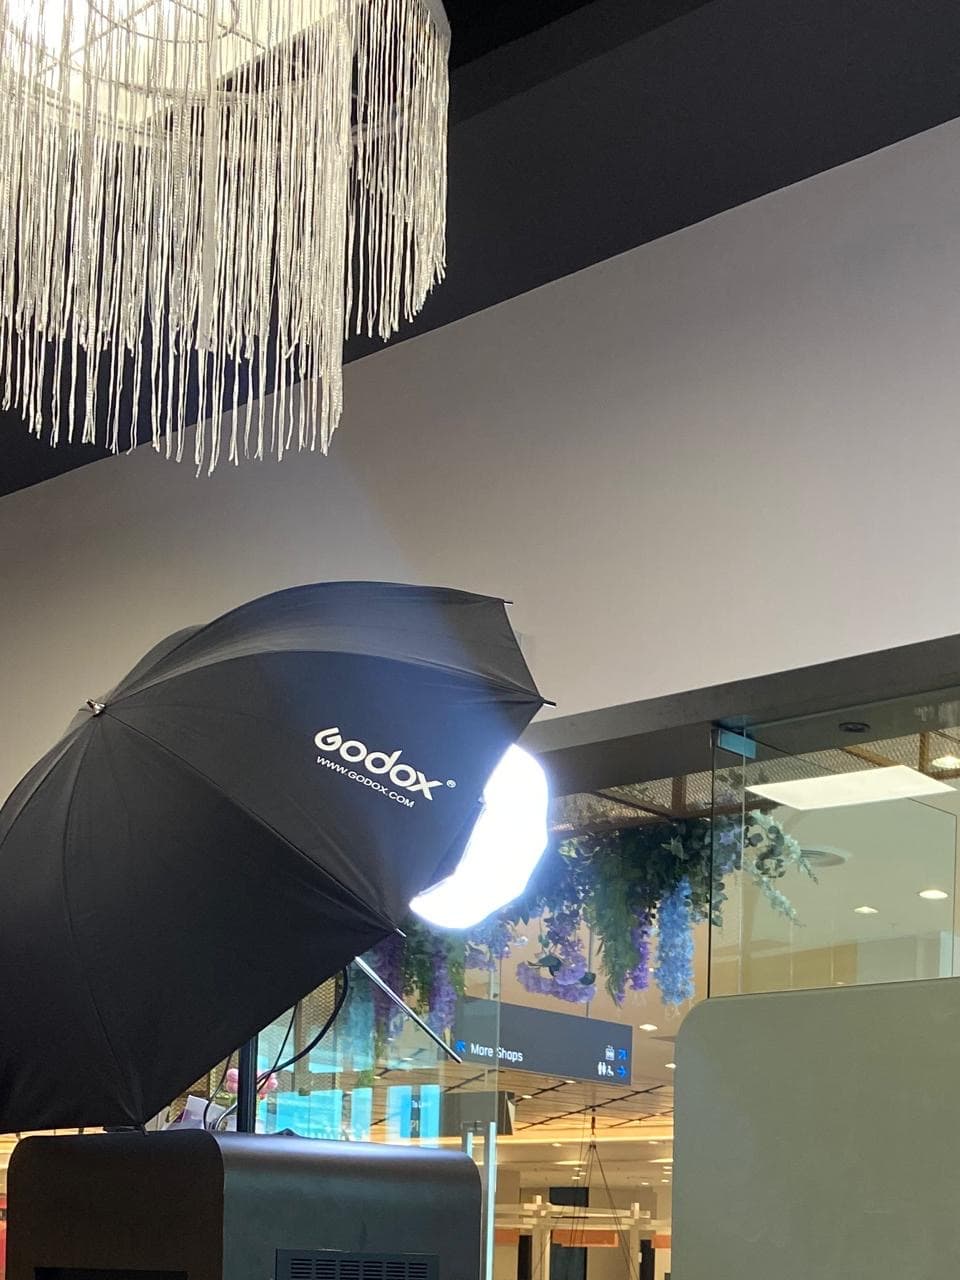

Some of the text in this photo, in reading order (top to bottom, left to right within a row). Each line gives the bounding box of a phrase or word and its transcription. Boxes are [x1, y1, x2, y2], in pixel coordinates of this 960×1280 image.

[317, 755, 415, 808] WWW.GODOX.COM
[470, 1042, 523, 1063] More Shops
